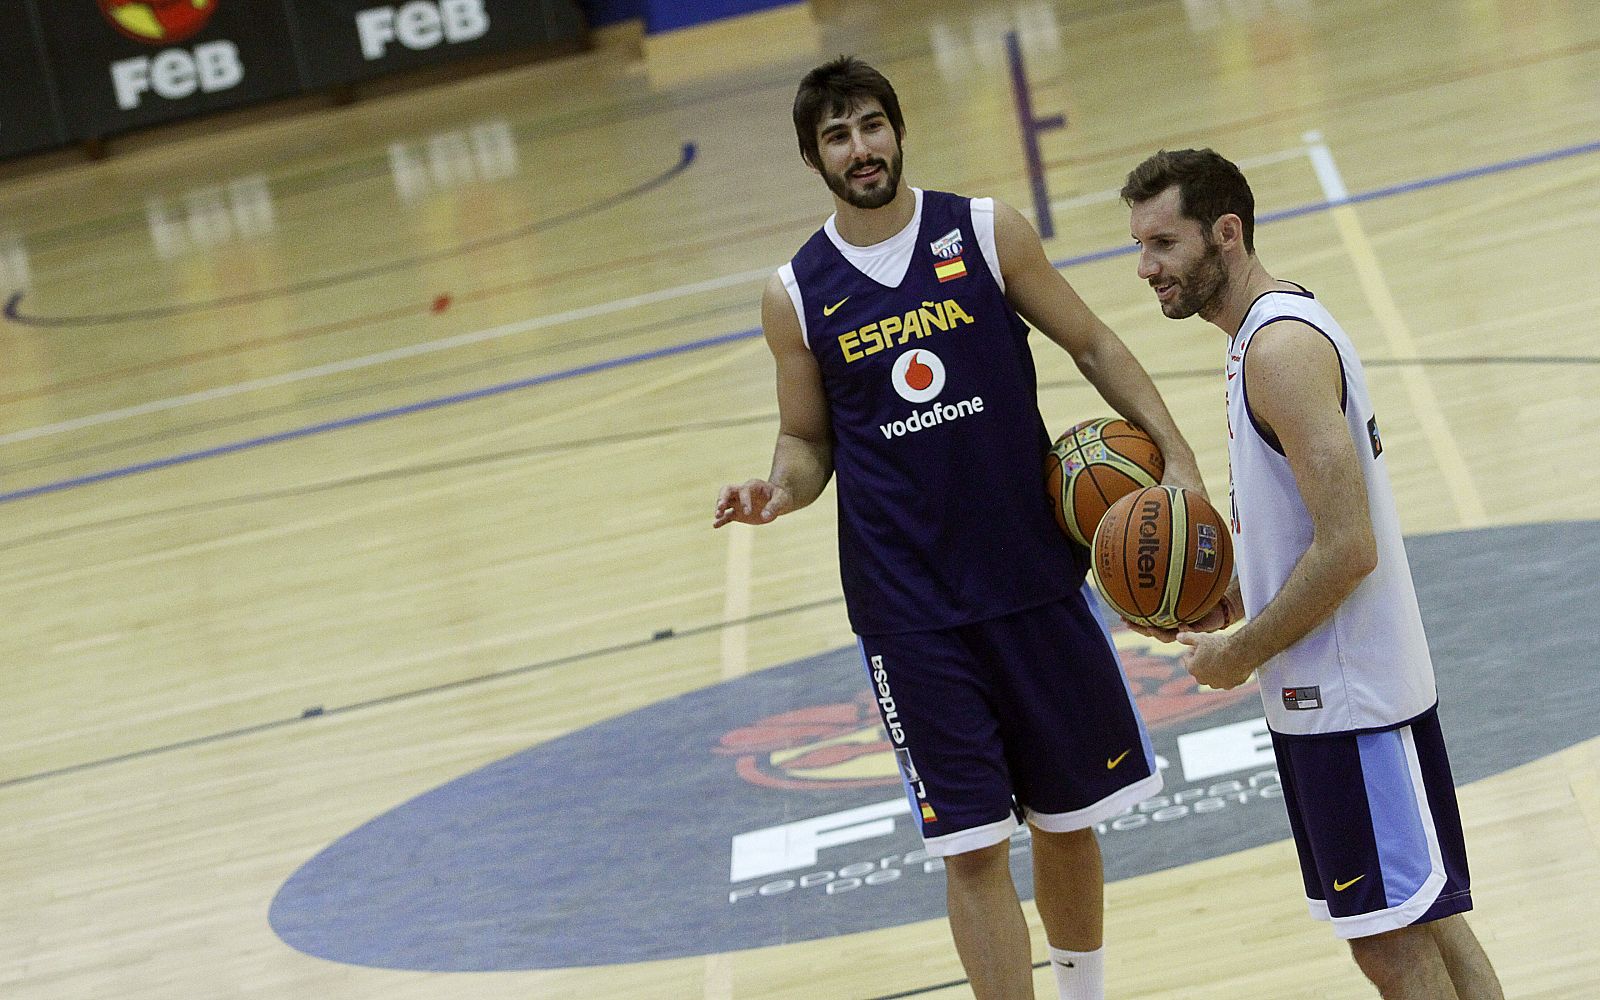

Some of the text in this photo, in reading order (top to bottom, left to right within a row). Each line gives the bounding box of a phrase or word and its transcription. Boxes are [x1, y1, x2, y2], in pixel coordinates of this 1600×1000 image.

[838, 299, 974, 363] ESPAÑA
[880, 396, 984, 439] vodafone
[1138, 500, 1161, 589] molten
[871, 655, 905, 745] endesa
